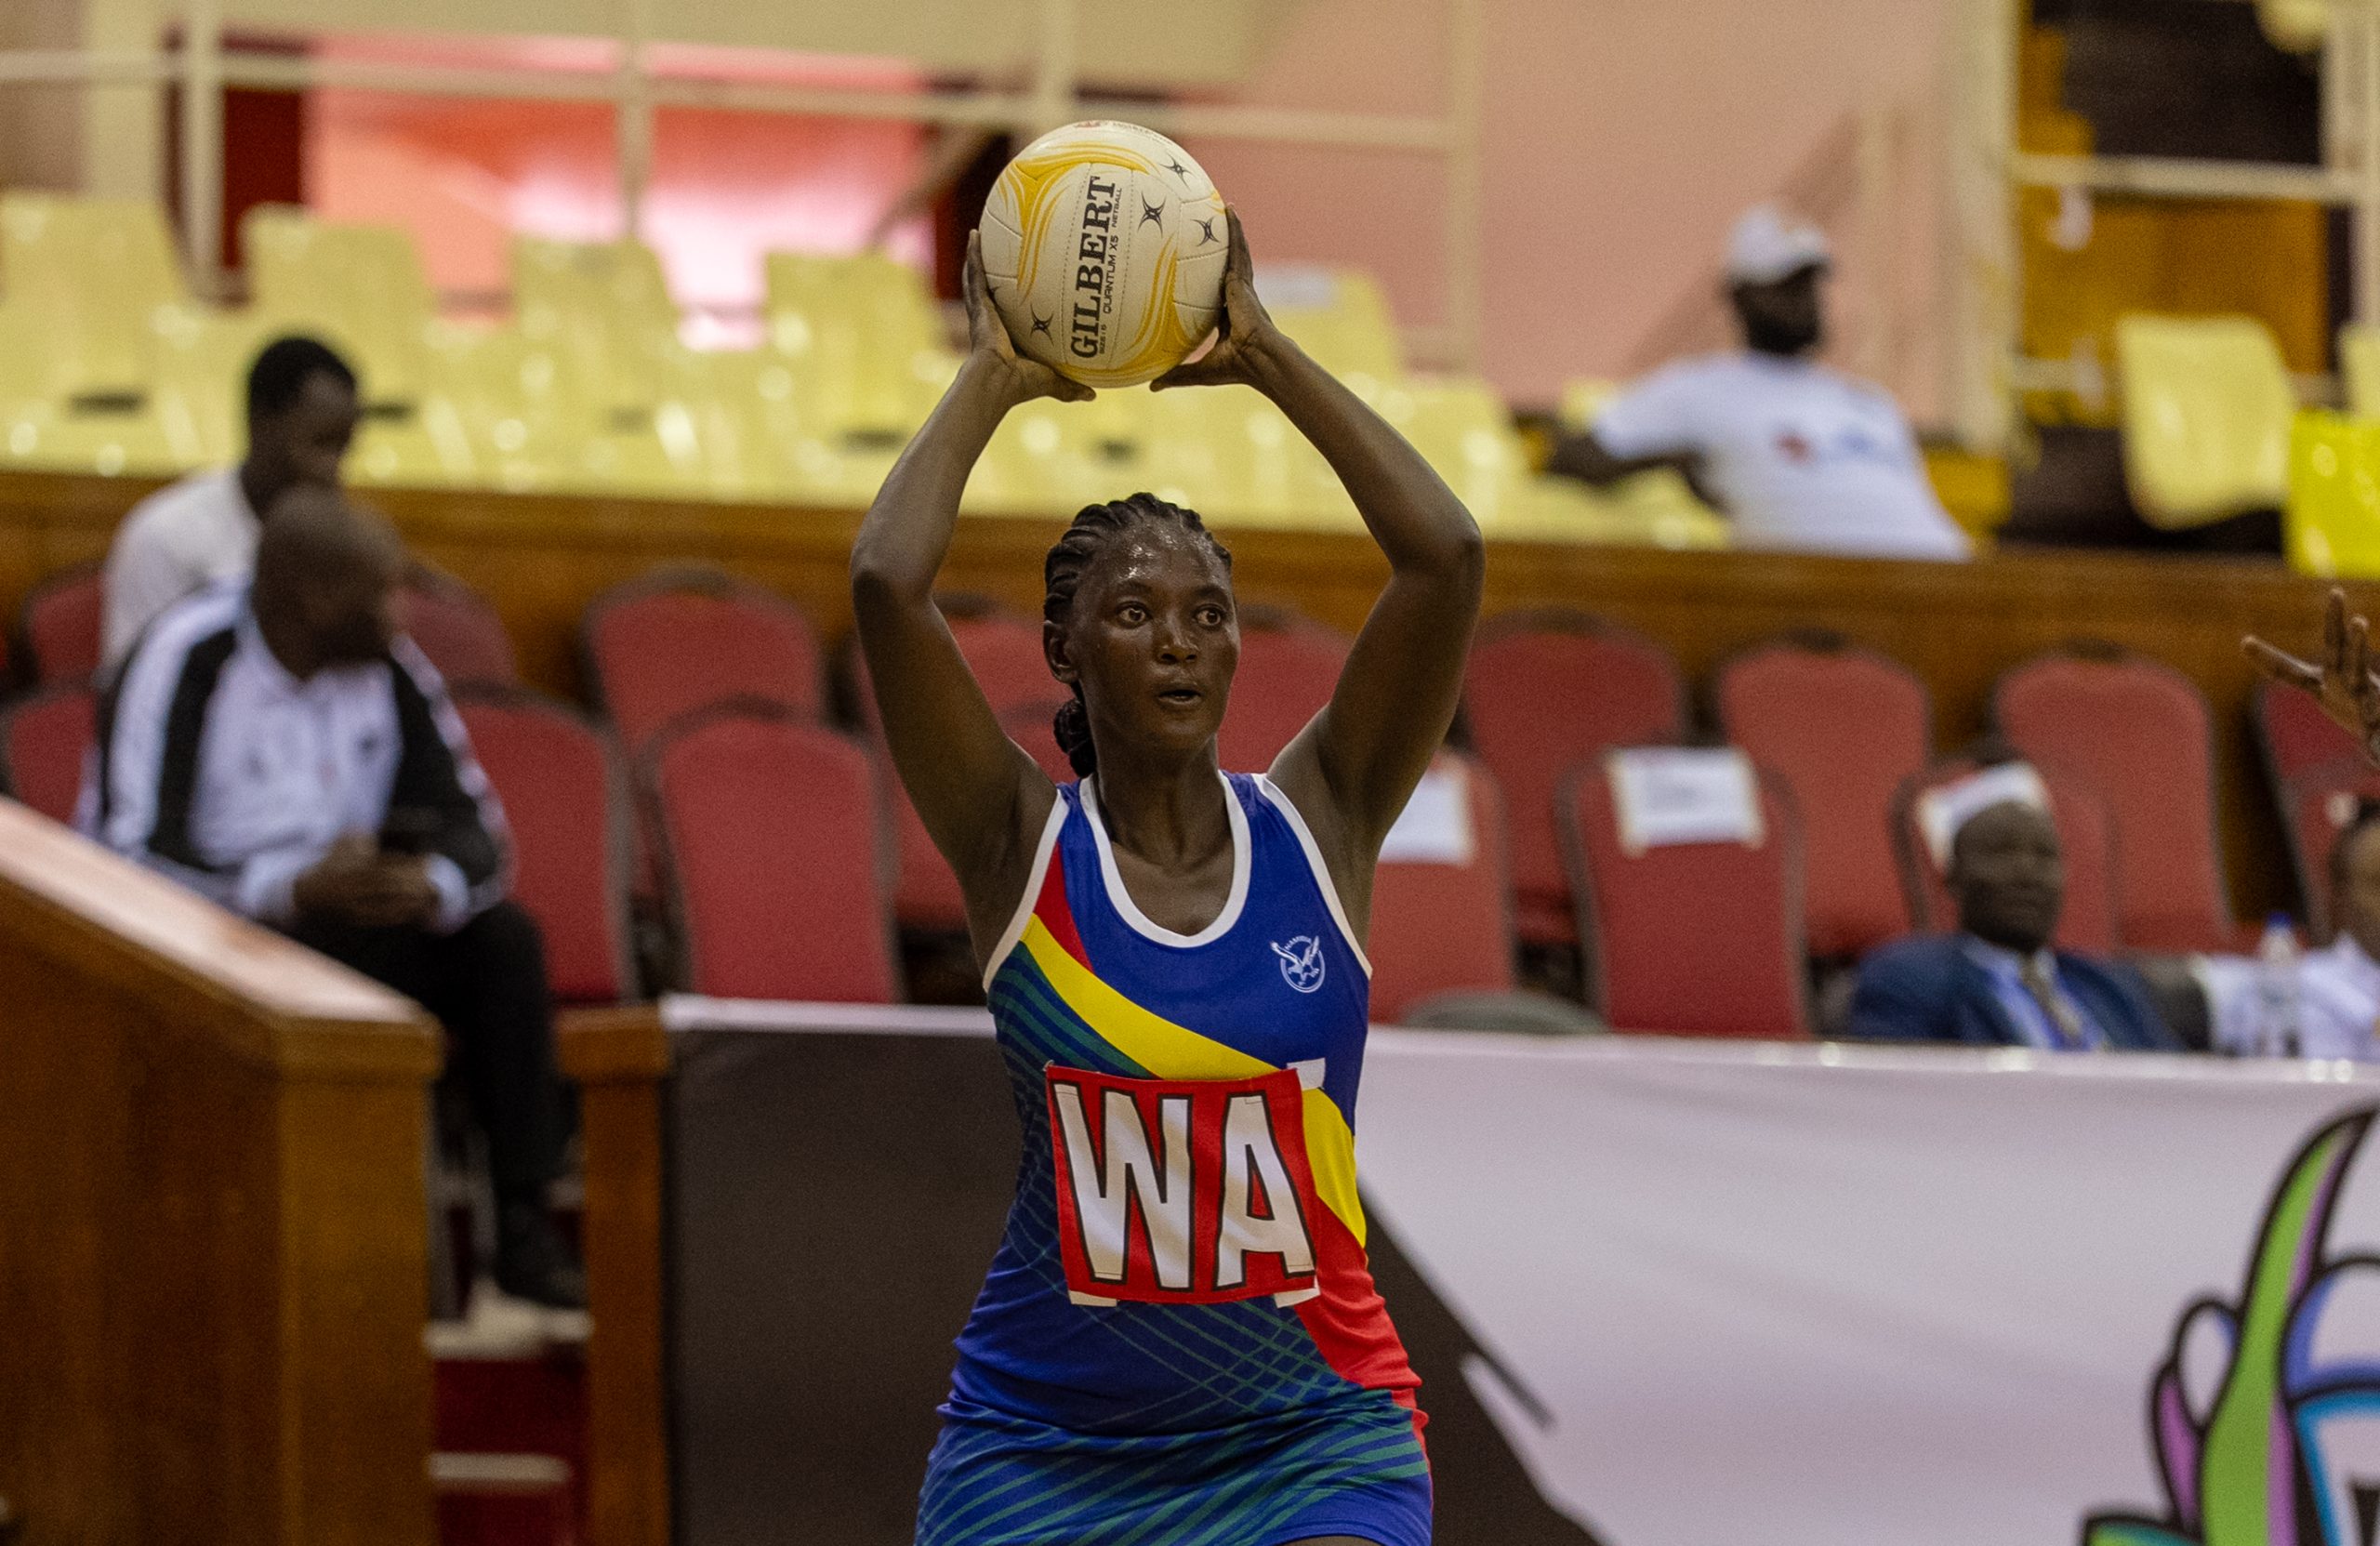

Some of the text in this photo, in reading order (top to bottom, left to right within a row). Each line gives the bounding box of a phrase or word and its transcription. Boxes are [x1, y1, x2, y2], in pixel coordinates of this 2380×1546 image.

[1071, 176, 1116, 358] GILBERT
[1103, 255, 1117, 314] QUANTUM
[1112, 188, 1122, 228] NETBALL
[1052, 1082, 1316, 1291] WA
